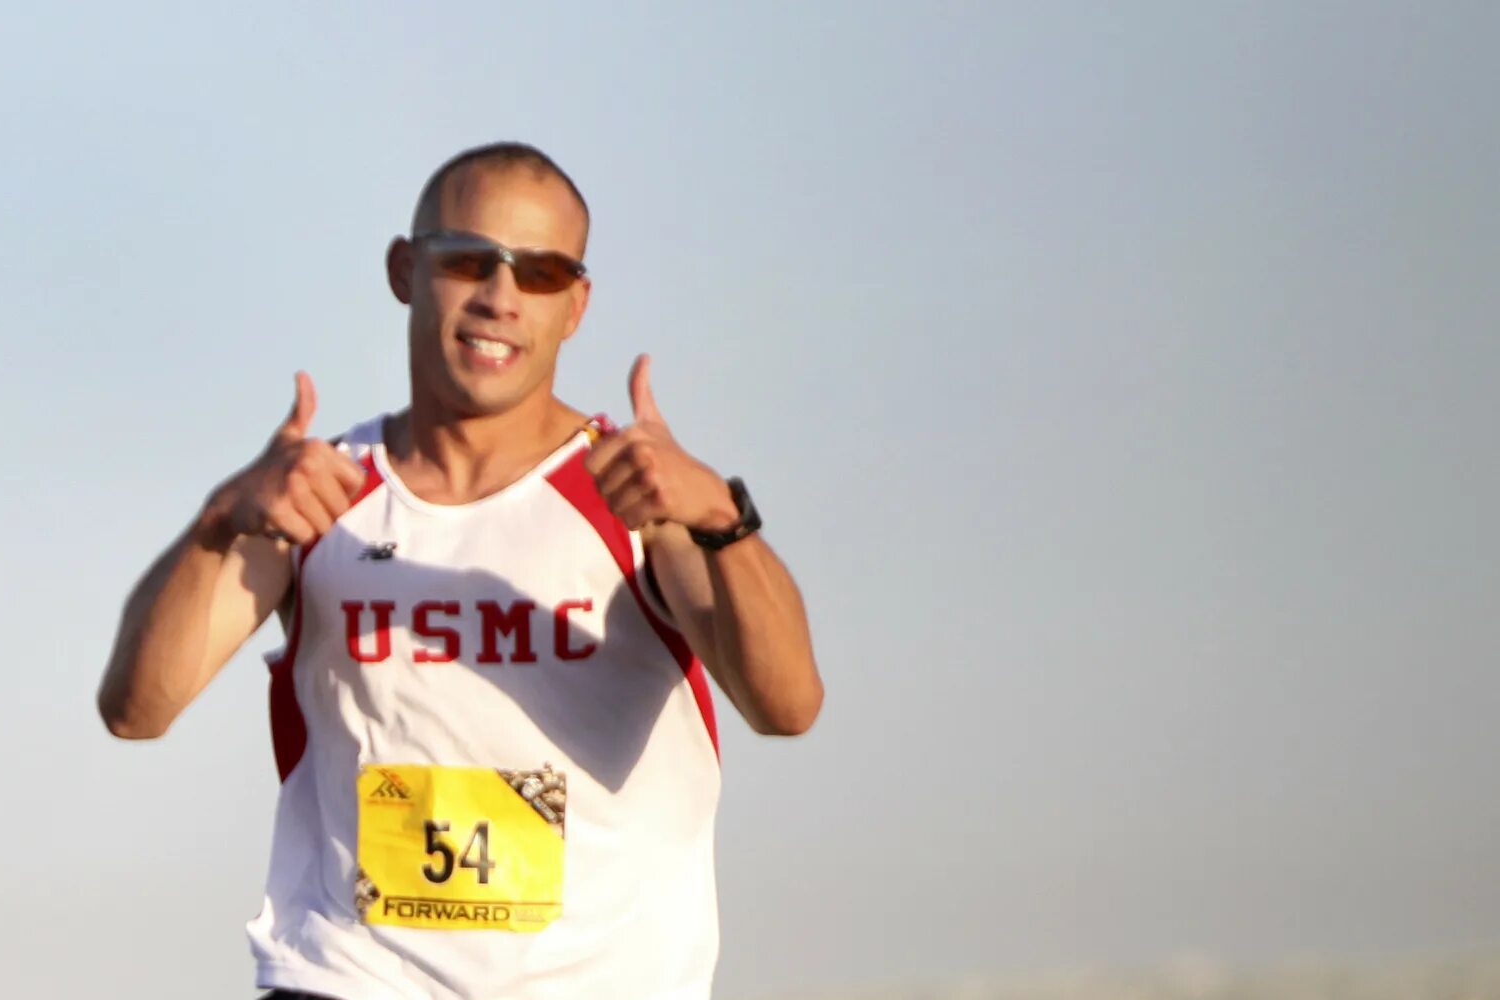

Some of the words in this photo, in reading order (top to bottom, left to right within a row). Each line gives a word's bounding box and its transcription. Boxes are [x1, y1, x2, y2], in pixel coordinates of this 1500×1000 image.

[340, 600, 597, 663] USMC
[422, 820, 496, 884] 54
[383, 898, 511, 922] FORWARD
